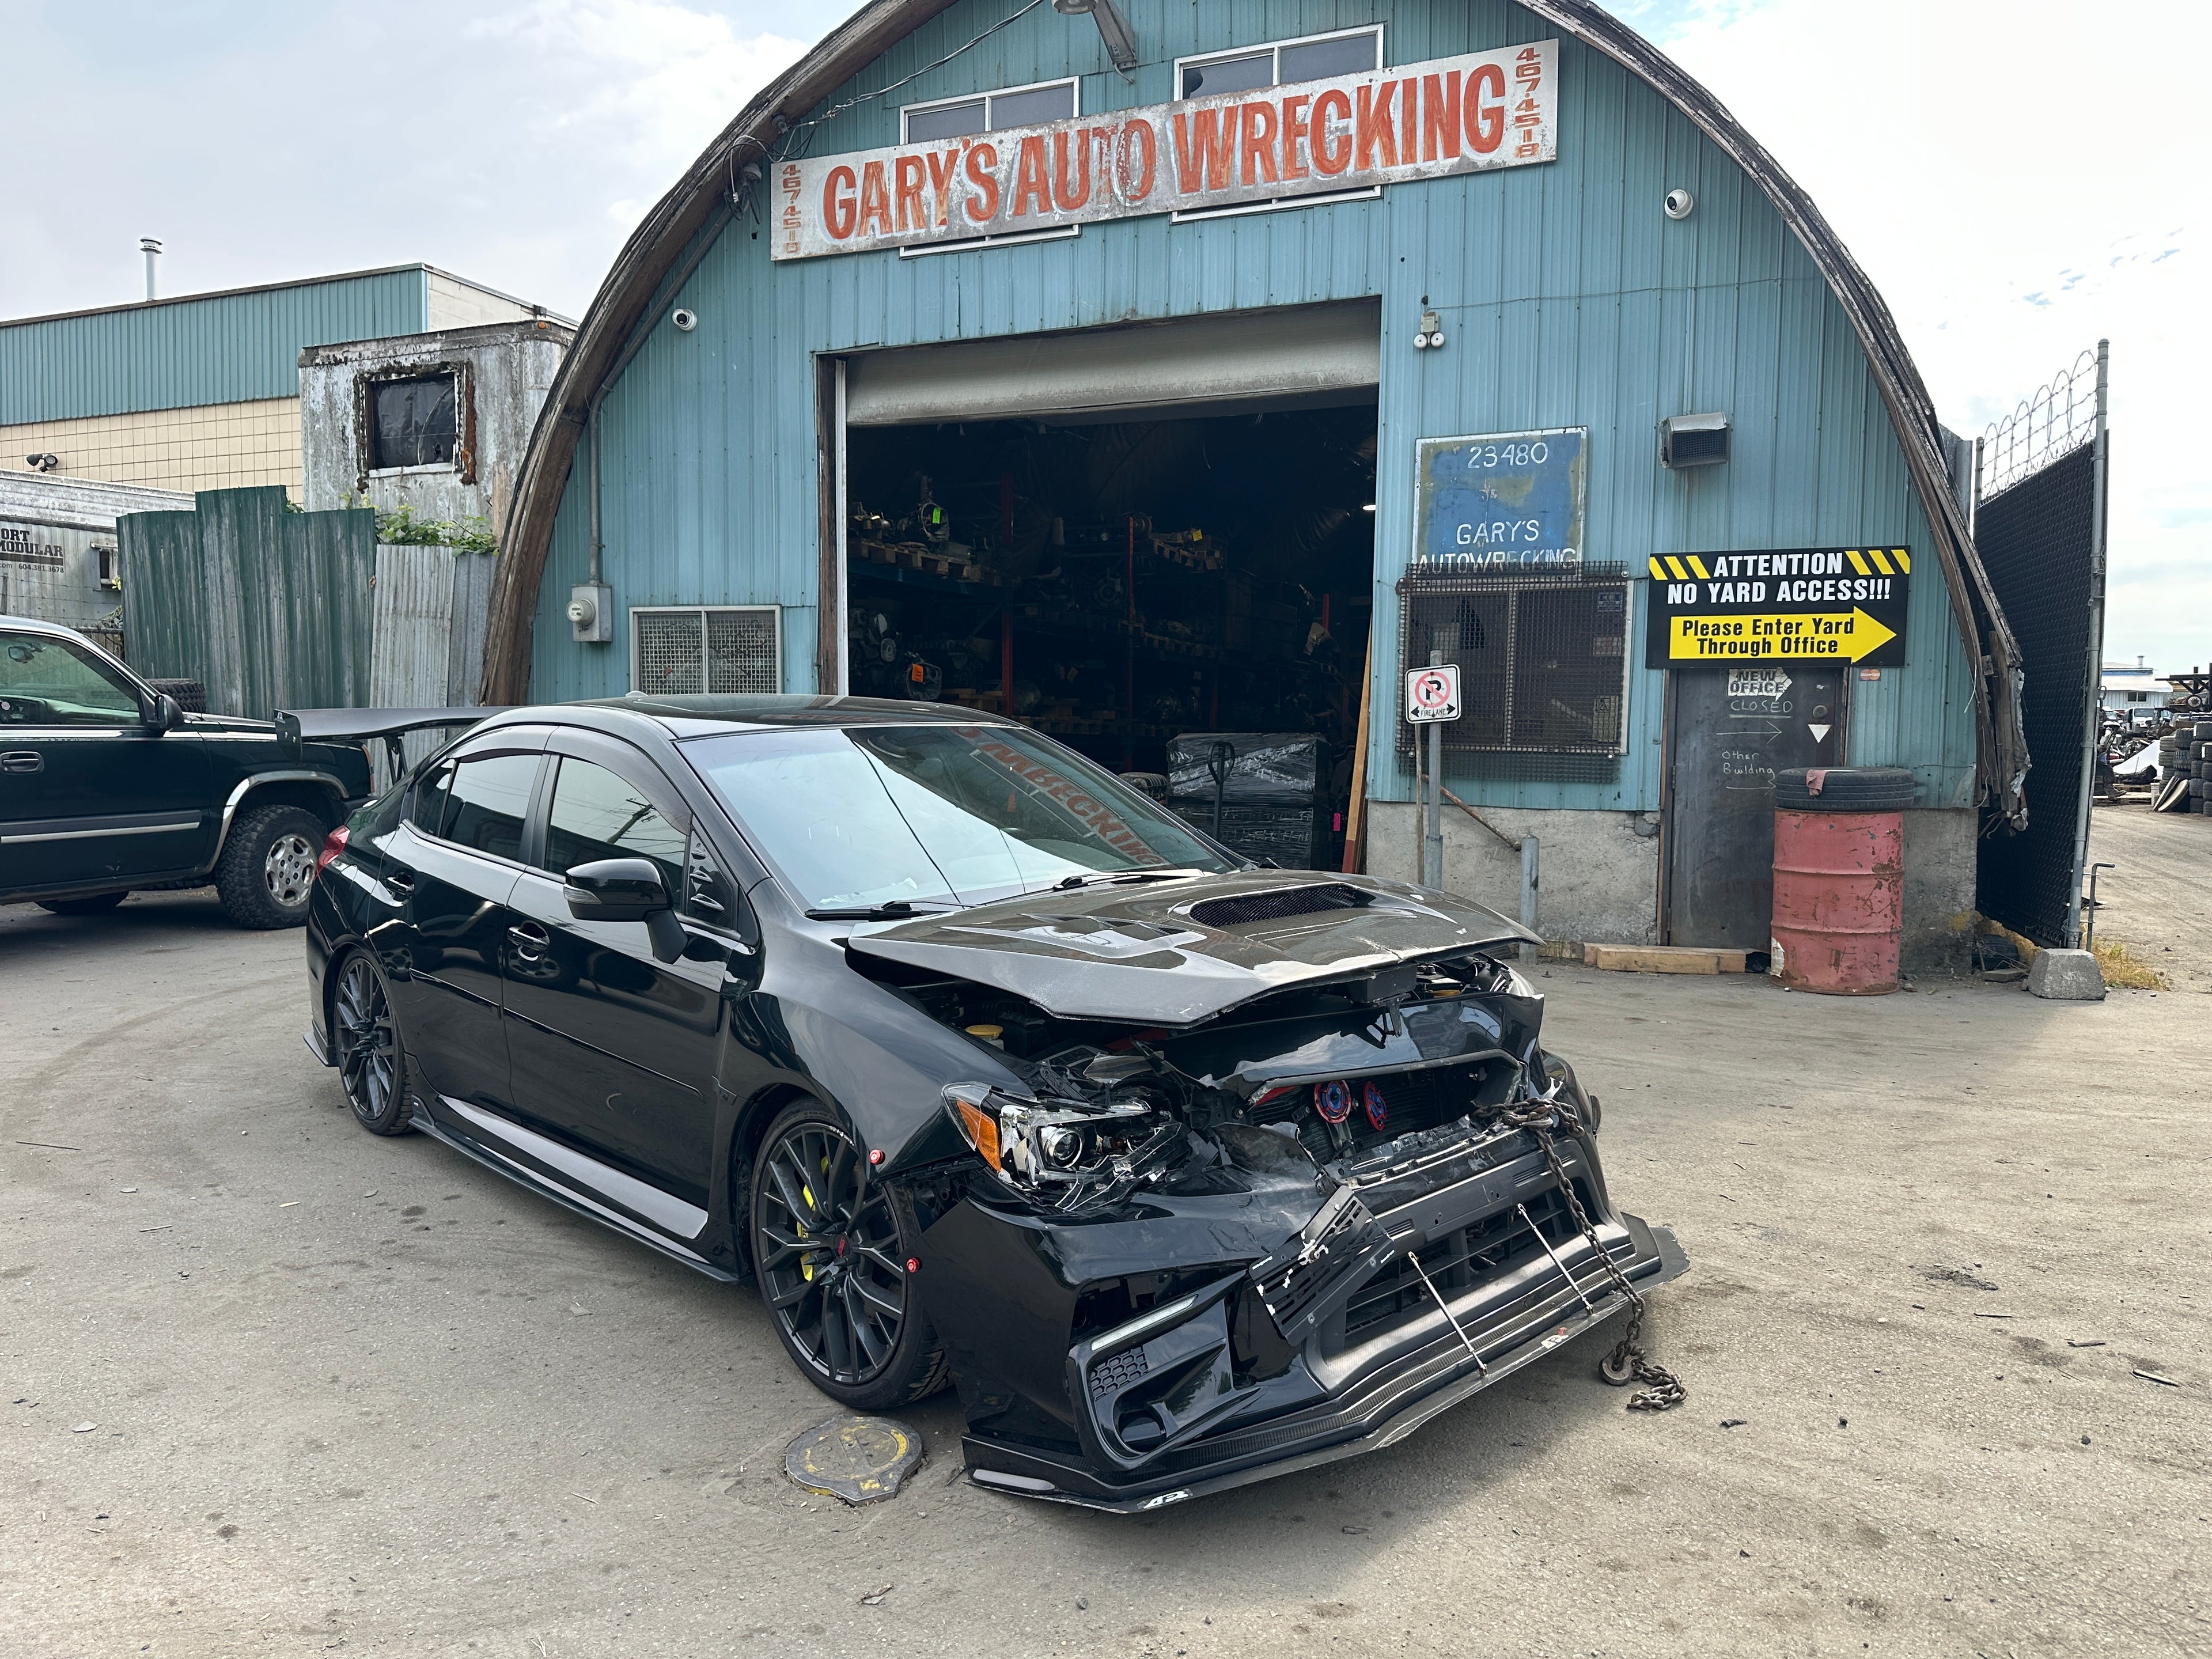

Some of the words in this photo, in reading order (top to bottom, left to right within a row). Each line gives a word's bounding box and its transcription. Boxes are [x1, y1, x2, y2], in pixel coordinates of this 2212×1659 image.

[822, 138, 1000, 240] GARY'S
[1013, 119, 1156, 217] AUTO
[1173, 64, 1506, 194] WRECKING
[1467, 442, 1549, 468] 23480
[1456, 520, 1540, 545] GARY'S
[1416, 548, 1577, 574] AUTOWRECKING
[1713, 552, 1843, 577] ATTENTION
[1667, 583, 1698, 604] NO
[1709, 581, 1766, 603] YARD
[1777, 578, 1891, 603] ACCESS!!!
[1682, 620, 1743, 637] Please
[1752, 618, 1804, 635] Enter
[1812, 617, 1854, 634] Yard
[1697, 638, 1771, 657] Through
[1781, 637, 1838, 654] Office
[1738, 670, 1775, 681] NEW
[1730, 681, 1785, 693] OFFICE
[1730, 699, 1793, 713] CLOSED
[1723, 763, 1775, 781] Building
